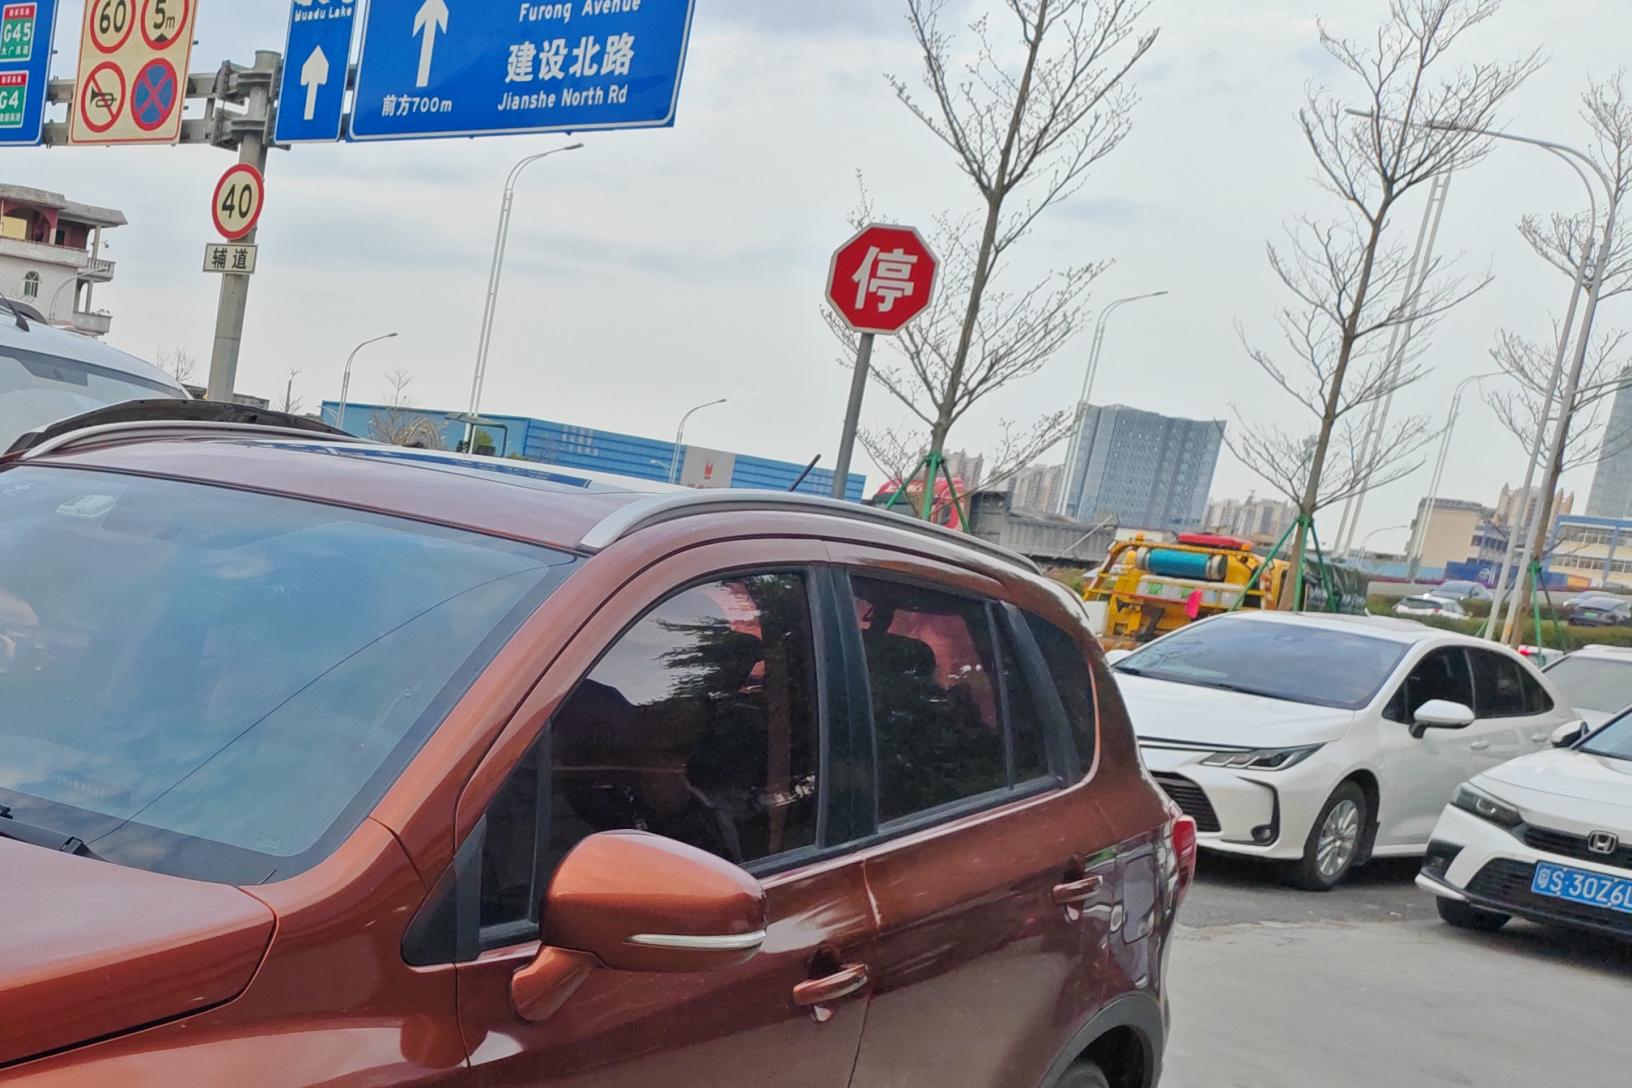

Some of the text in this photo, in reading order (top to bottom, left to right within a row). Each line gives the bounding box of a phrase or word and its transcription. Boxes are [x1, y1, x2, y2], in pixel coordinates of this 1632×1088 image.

[99, 0, 126, 34] 60
[328, 6, 353, 19] Lake
[518, 0, 641, 24] Furong Avenue
[3, 23, 31, 43] G45
[505, 32, 635, 85] 建设北路
[380, 94, 452, 117] 前方700m
[497, 84, 628, 112] Jianshe North Rd
[221, 183, 253, 219] 40
[211, 247, 248, 270] 辅道
[851, 245, 919, 312] 停
